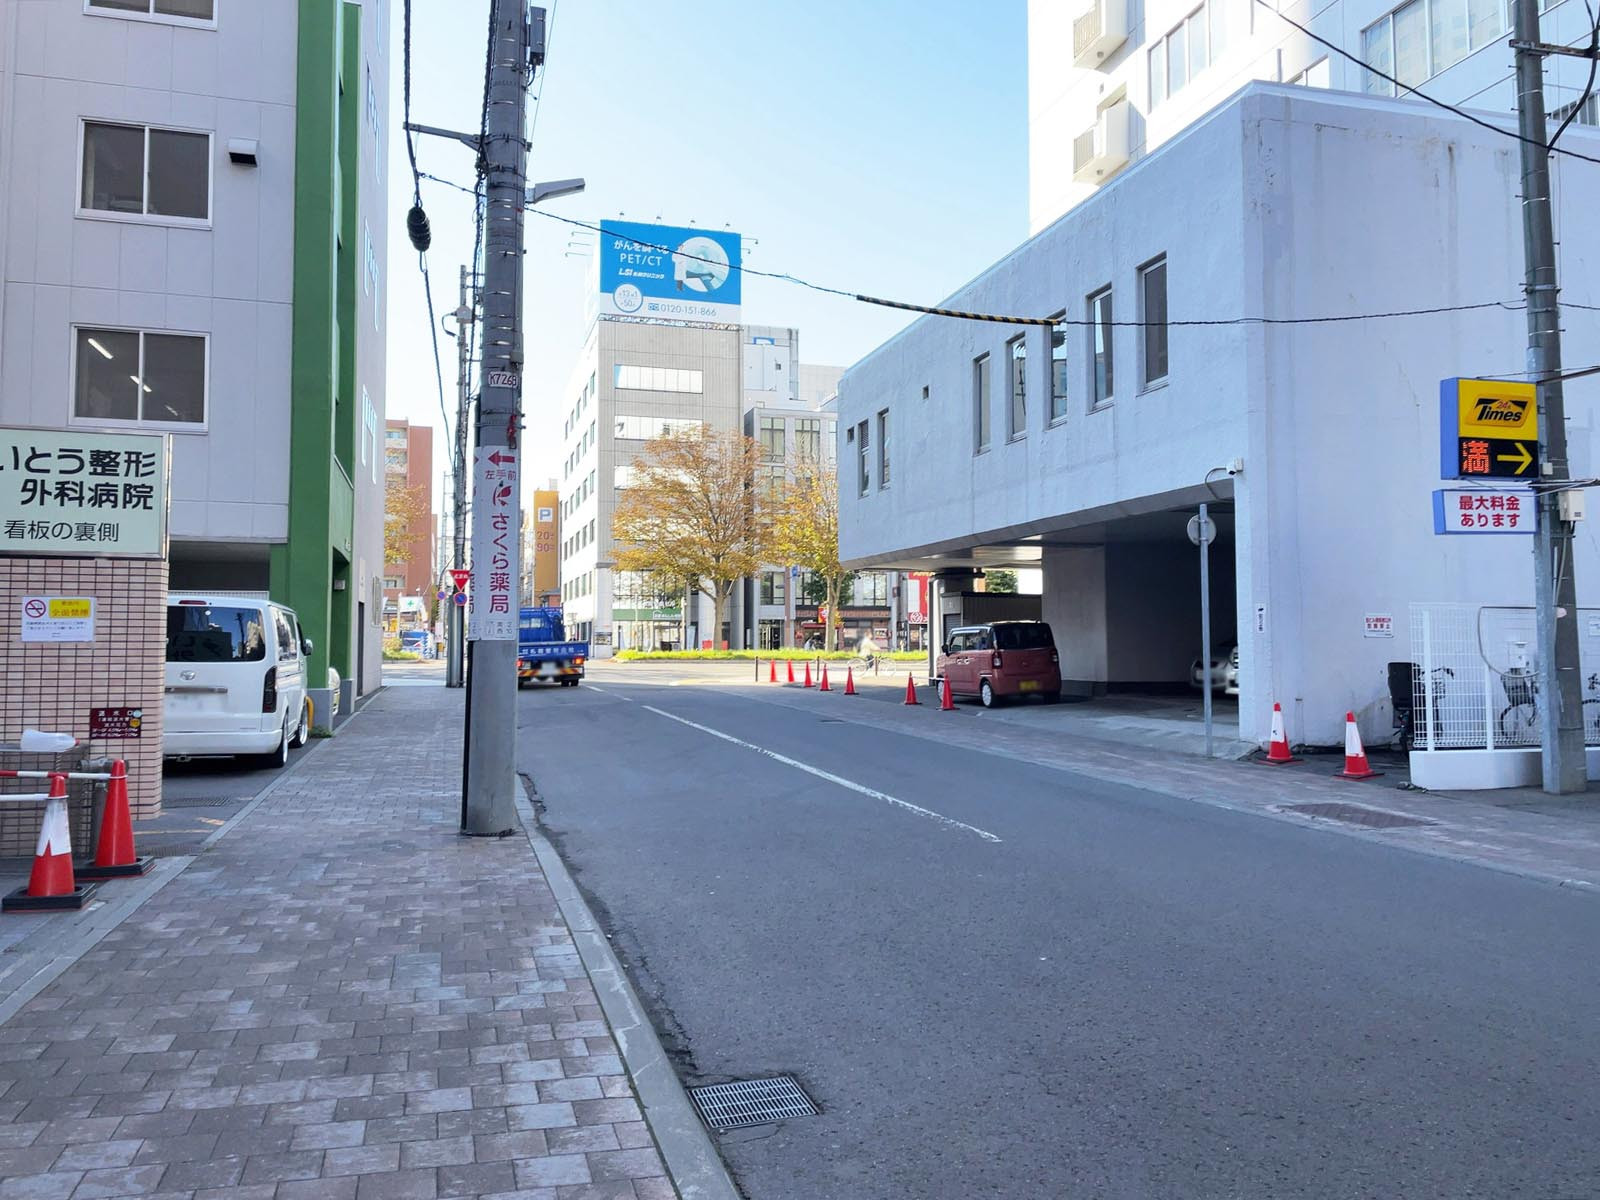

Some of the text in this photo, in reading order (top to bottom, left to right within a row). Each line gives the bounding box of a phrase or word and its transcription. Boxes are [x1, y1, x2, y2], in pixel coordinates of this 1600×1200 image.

[620, 253, 663, 266] PET/CT
[1477, 405, 1523, 422] Times
[0, 445, 156, 478] いとう整形
[1462, 440, 1490, 474] 満
[485, 469, 517, 481] 左手前
[20, 478, 154, 510] 外科病院
[1459, 495, 1521, 511] 最大料金
[3, 519, 120, 542] 看板の裏側
[1460, 513, 1521, 528] あります
[489, 512, 510, 614] さくら薬局
